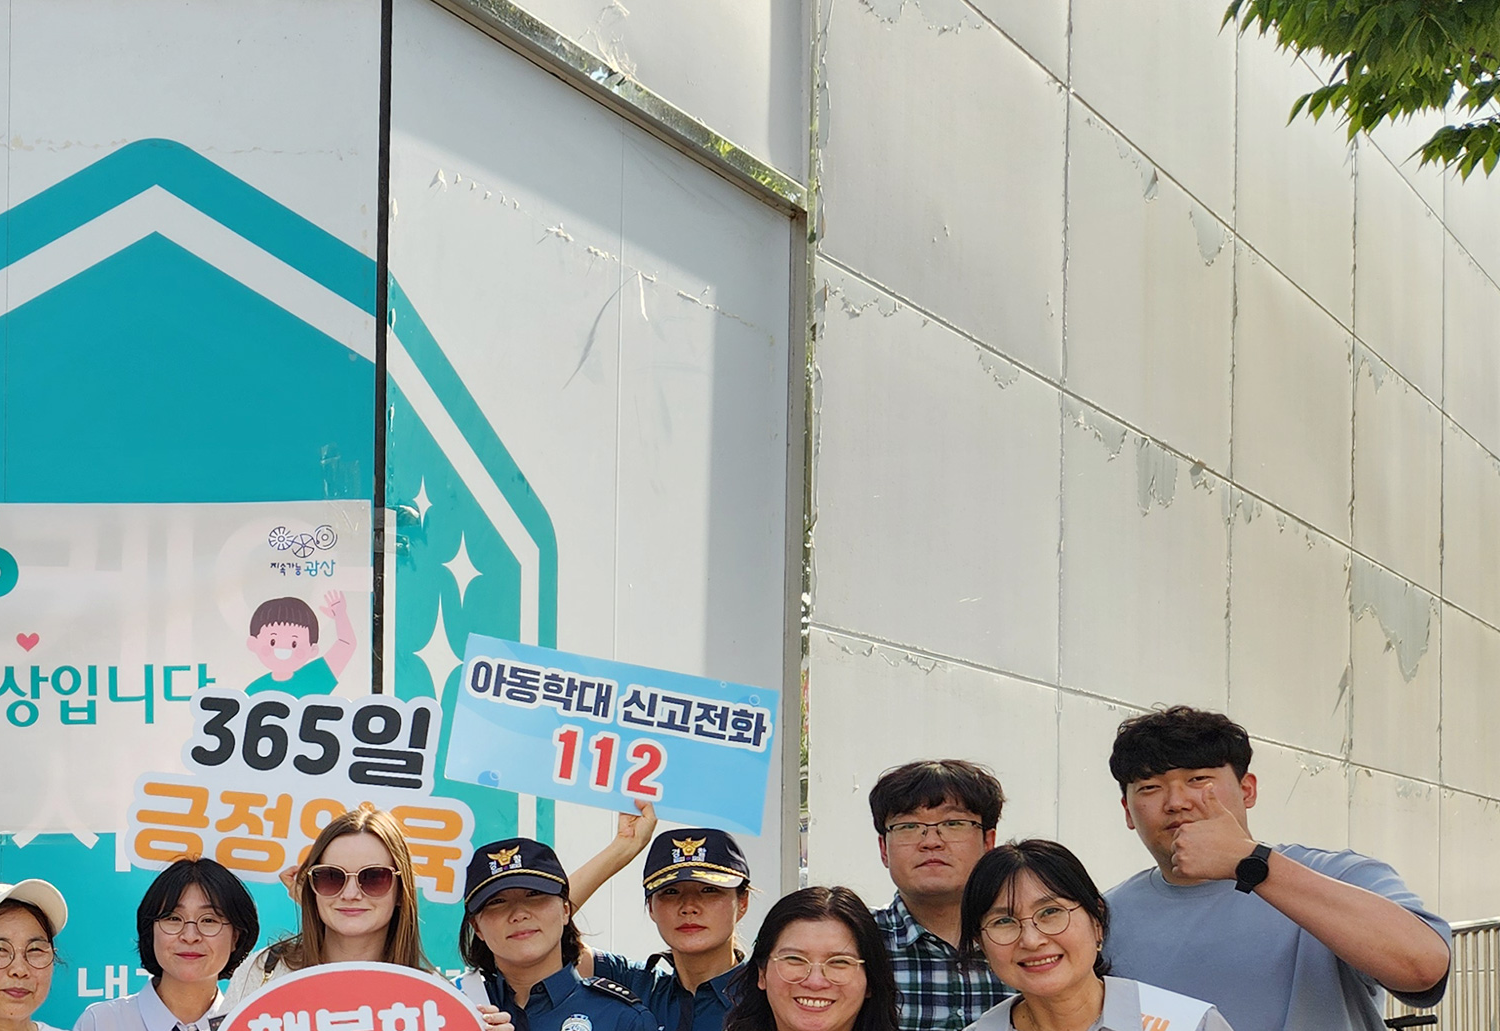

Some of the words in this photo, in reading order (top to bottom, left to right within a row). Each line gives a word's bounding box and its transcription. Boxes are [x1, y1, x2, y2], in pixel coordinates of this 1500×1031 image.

[303, 558, 337, 578] 광산
[190, 694, 432, 792] 365일
[470, 658, 613, 721] 아동학대
[621, 686, 770, 749] 신고전화
[553, 727, 665, 798] 112
[132, 780, 466, 897] 긍정육
